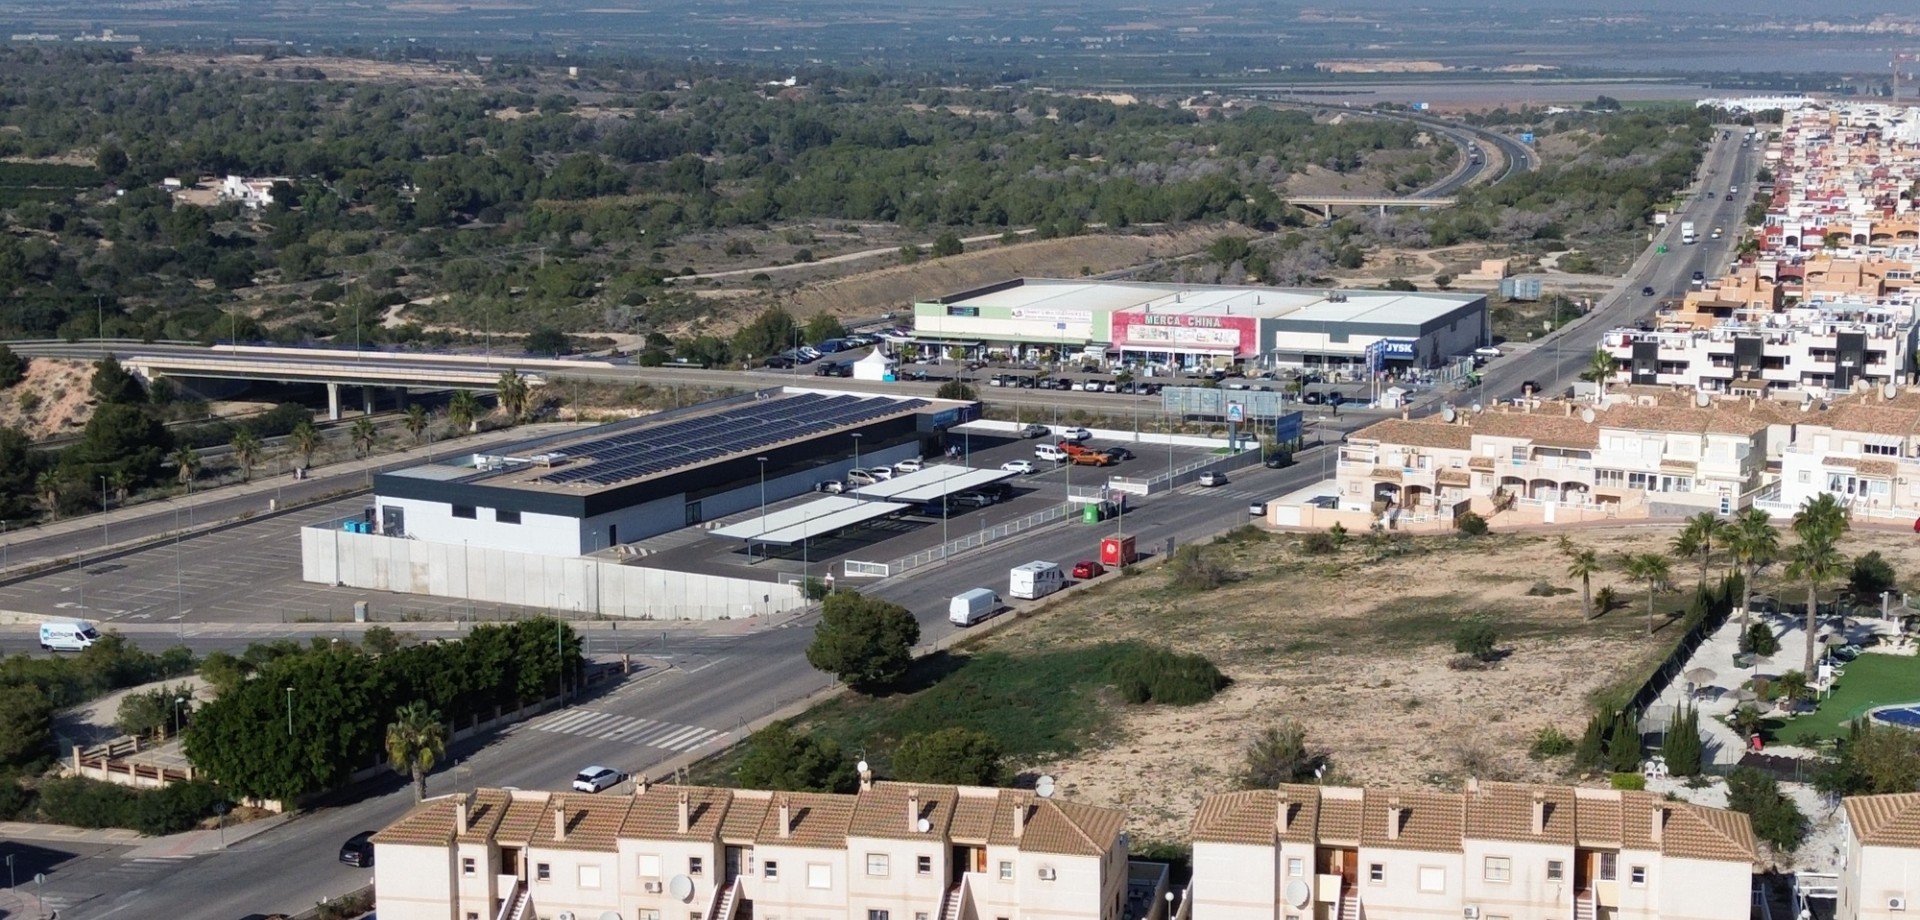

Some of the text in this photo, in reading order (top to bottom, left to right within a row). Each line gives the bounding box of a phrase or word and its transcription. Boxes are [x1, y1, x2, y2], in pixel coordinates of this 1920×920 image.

[1145, 315, 1221, 327] MERCA CHINA
[1386, 343, 1413, 353] JYSK
